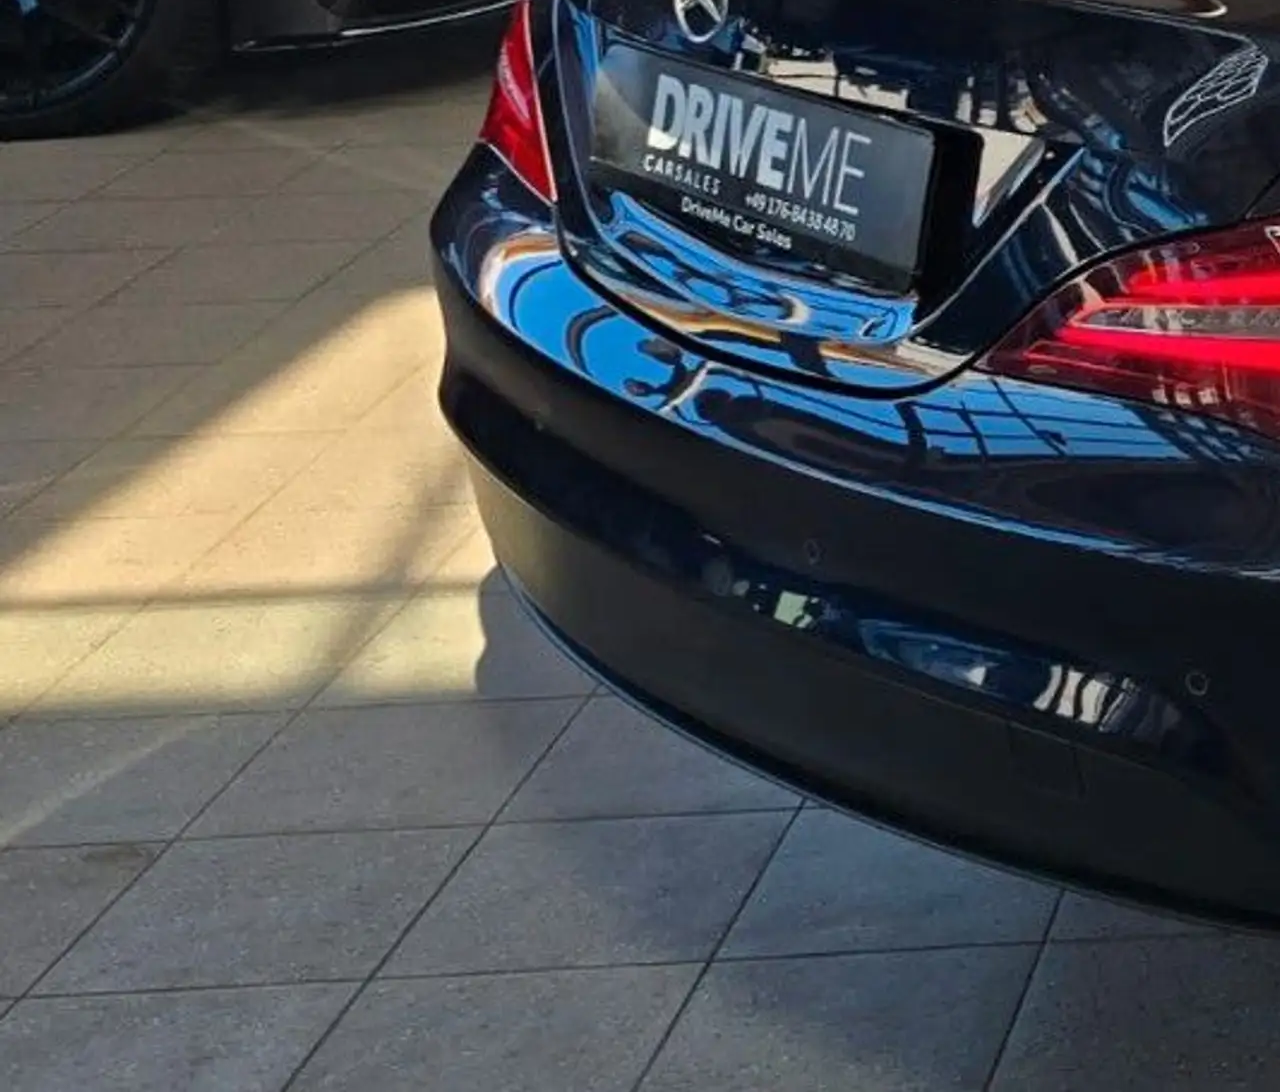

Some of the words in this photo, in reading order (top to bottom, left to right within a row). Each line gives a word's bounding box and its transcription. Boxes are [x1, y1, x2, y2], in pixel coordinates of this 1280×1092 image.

[642, 153, 722, 196] CARSALES
[732, 213, 755, 236] Car
[755, 222, 793, 251] Sales
